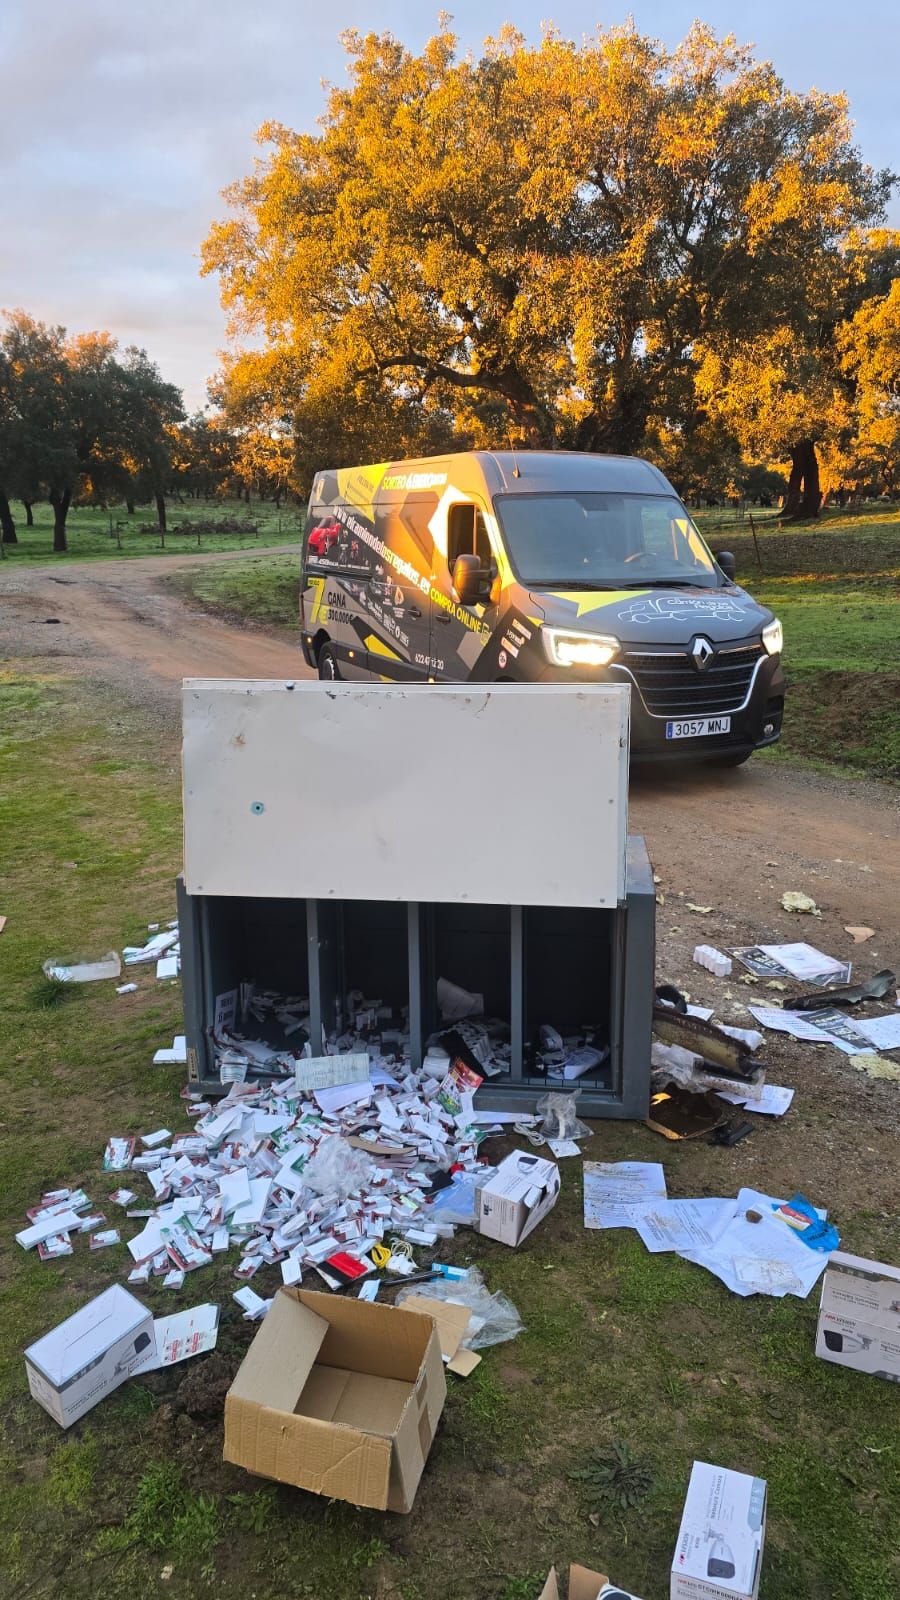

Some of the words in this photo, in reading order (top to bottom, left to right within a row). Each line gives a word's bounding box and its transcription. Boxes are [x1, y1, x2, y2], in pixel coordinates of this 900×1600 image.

[327, 591, 346, 609] GANA
[430, 587, 456, 617] COMPRA
[456, 607, 481, 634] ONLINE
[675, 722, 704, 737] 3057
[707, 718, 729, 734] MNJ
